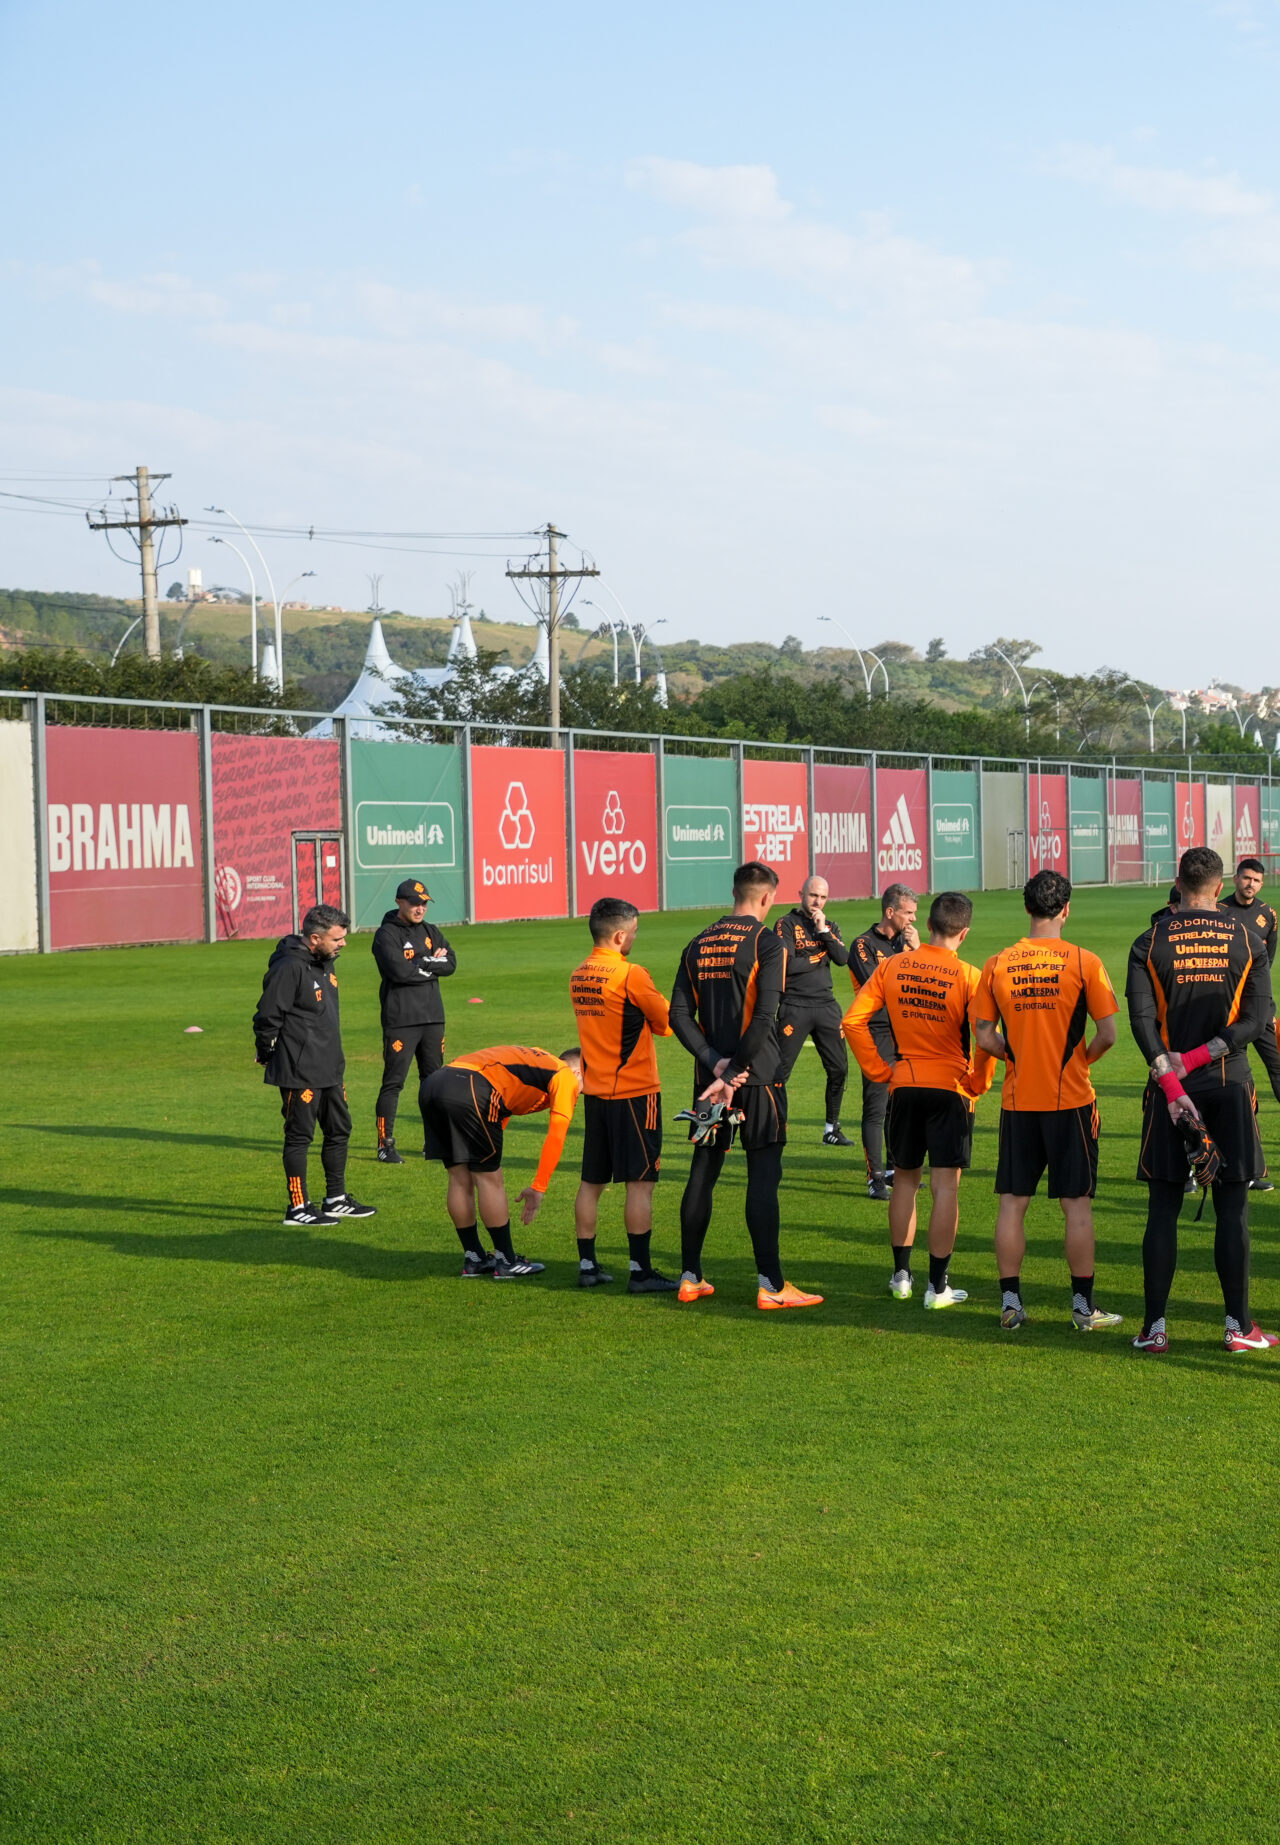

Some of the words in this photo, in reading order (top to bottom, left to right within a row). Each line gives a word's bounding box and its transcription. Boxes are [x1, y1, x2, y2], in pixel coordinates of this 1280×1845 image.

[744, 804, 805, 832] ESTRELA
[936, 818, 961, 832] Unimed
[48, 804, 194, 872] BRAHMA
[366, 825, 424, 846] Unimed
[672, 824, 711, 842] Unimed
[814, 812, 868, 854] BRAHMA
[766, 834, 793, 862] BET
[582, 840, 646, 876] vero
[878, 847, 922, 872] adidas
[483, 857, 553, 886] banrisul
[1184, 918, 1235, 930] banrisul
[700, 944, 738, 954] Unimed
[1022, 950, 1070, 959] banrisul
[1175, 943, 1228, 955] Unimed
[912, 960, 959, 977] banrisul
[1173, 957, 1229, 970] MARQUESPAN
[1012, 974, 1059, 985] Unimed
[572, 985, 602, 994] Unimed
[901, 985, 946, 1000] Unimed
[1010, 987, 1060, 999] MARQUESPAN
